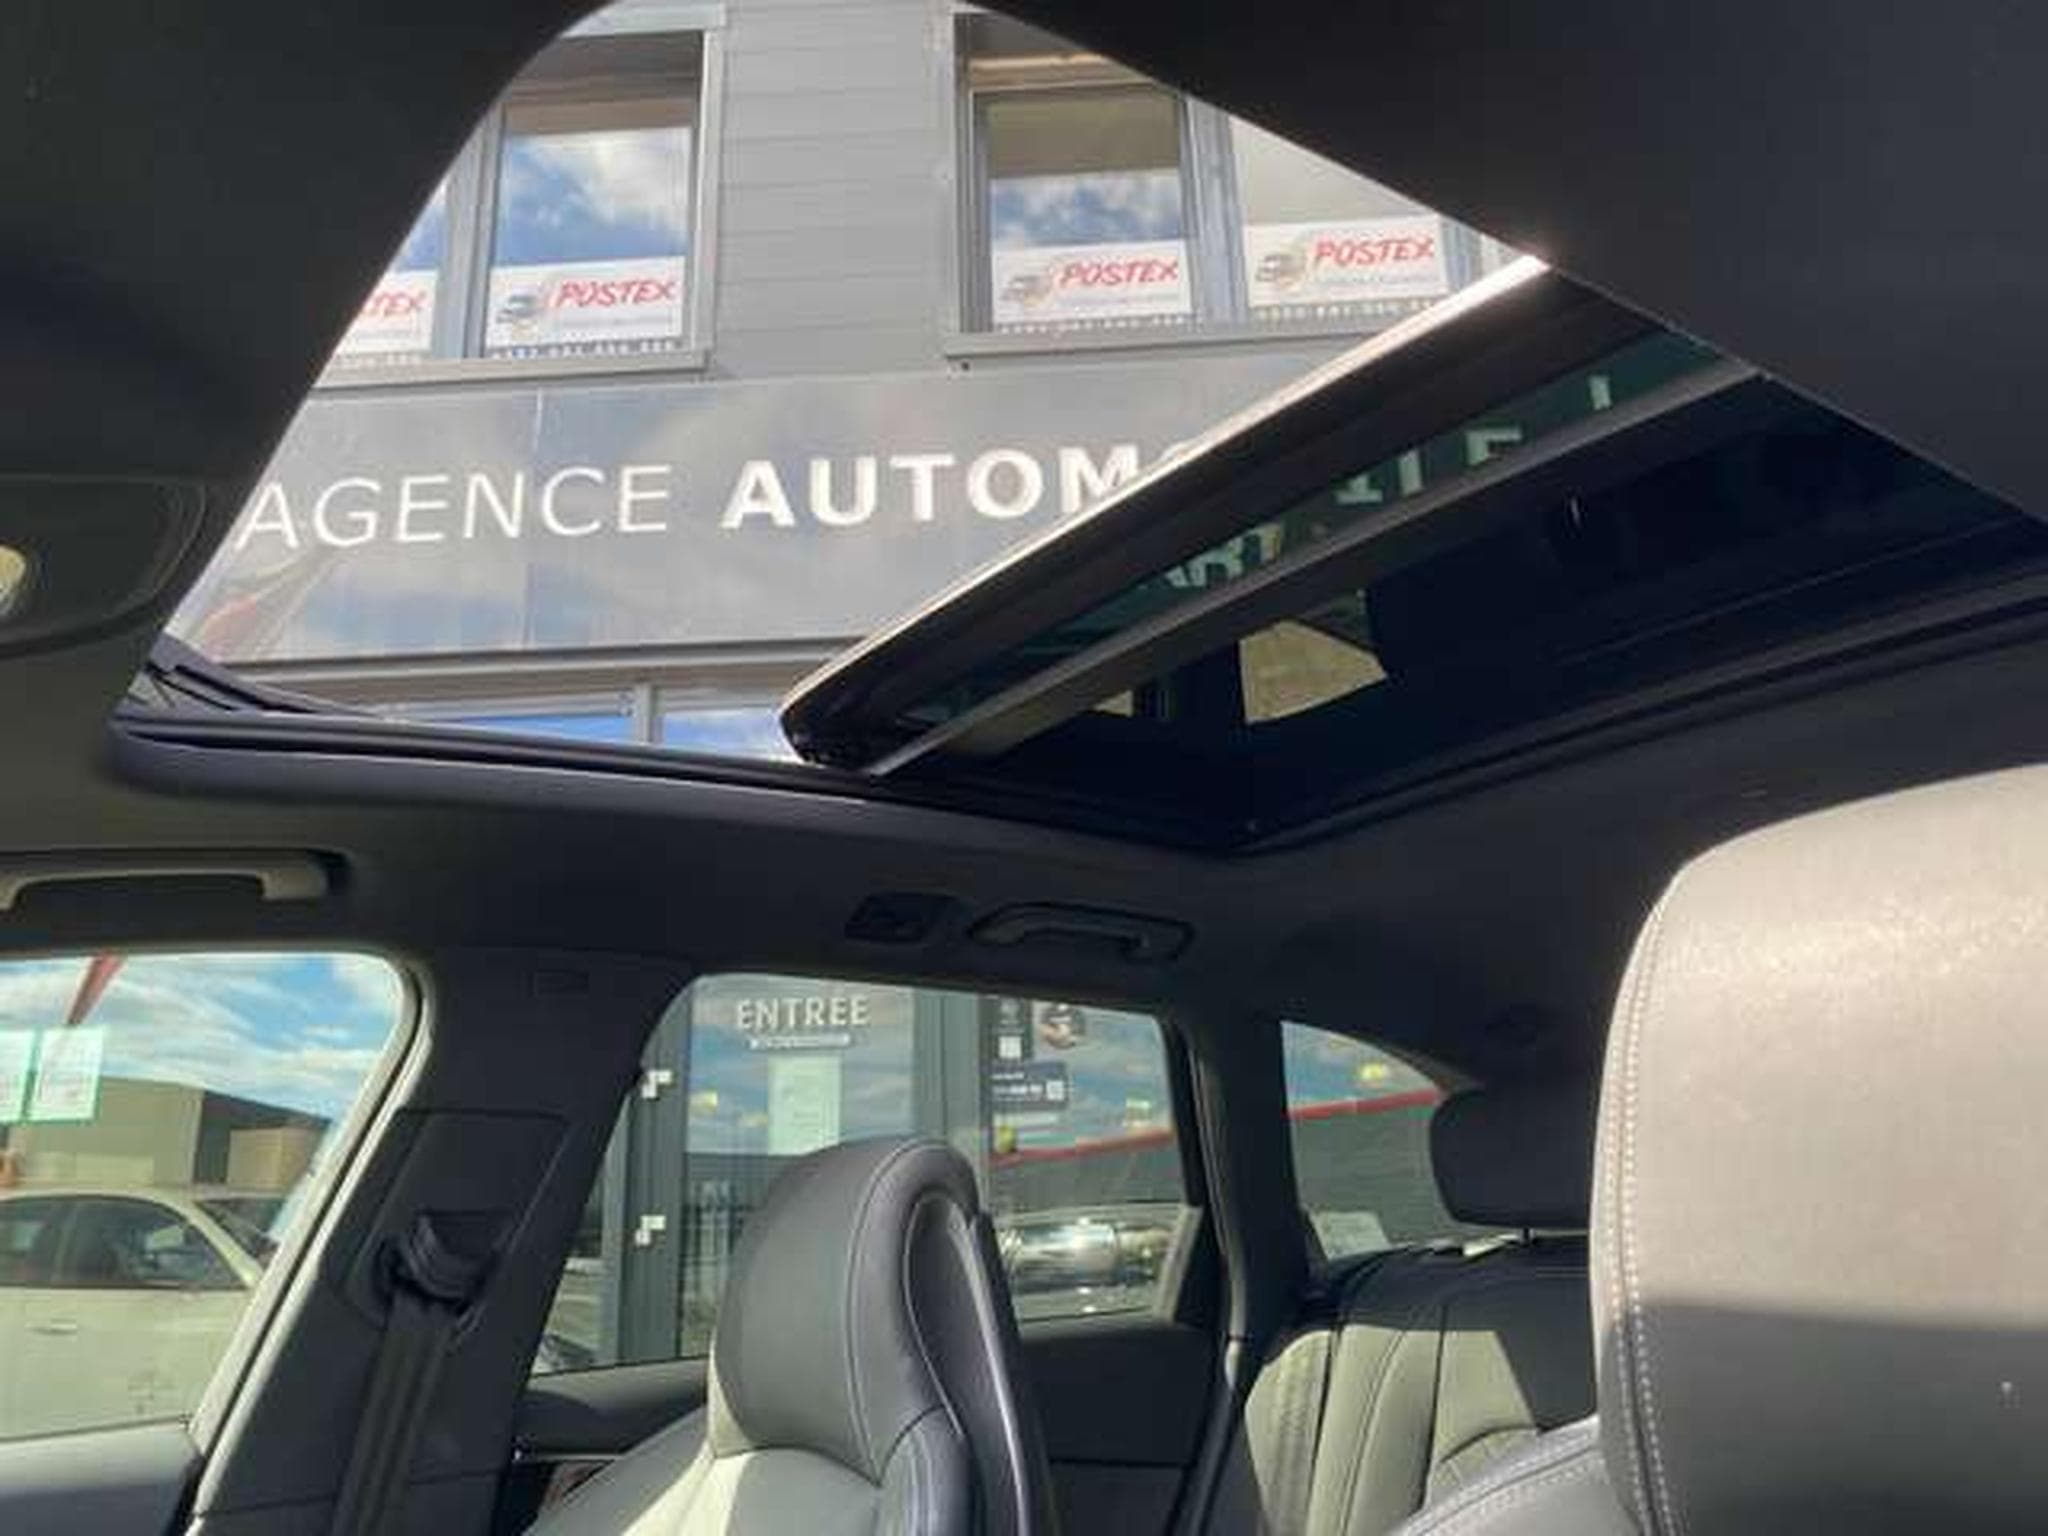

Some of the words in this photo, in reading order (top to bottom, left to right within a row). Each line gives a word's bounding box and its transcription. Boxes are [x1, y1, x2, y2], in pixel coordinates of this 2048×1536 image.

[1313, 235, 1435, 267] POSTEX
[1059, 257, 1180, 289] POSTEX
[554, 278, 677, 309] POSTEX
[233, 464, 672, 551] AGENCE
[720, 441, 1184, 529] AUTOM
